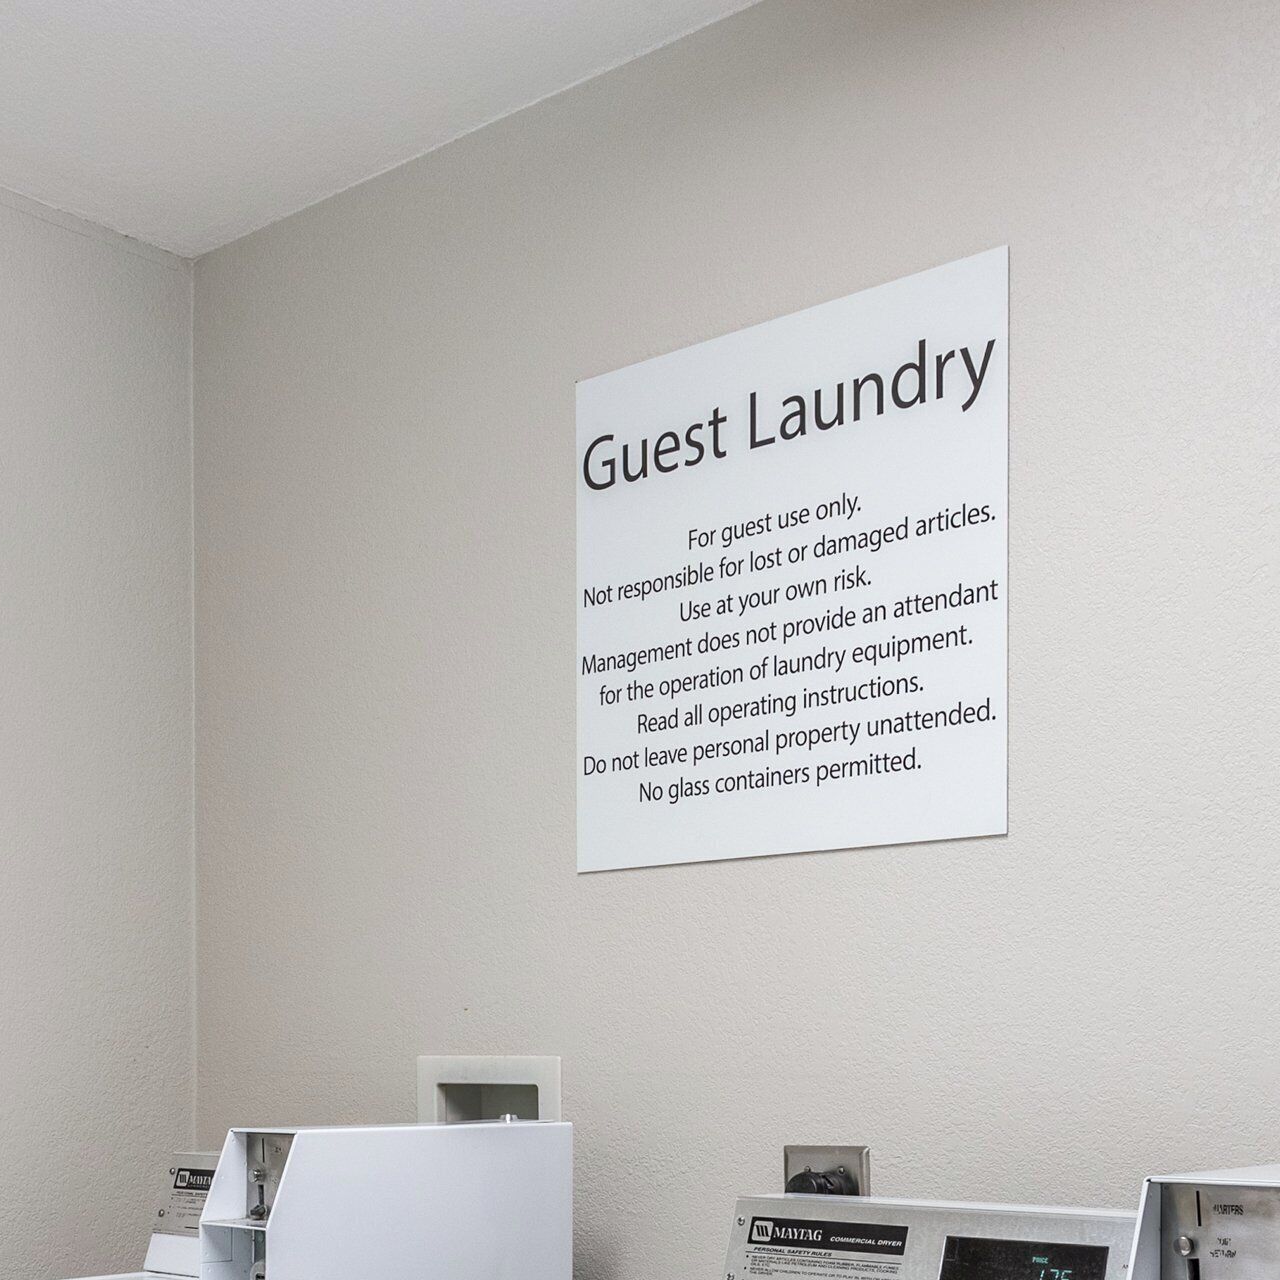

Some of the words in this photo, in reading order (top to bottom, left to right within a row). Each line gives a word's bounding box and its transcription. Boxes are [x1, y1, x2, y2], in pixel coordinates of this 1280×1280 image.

[583, 407, 726, 490] Guest
[749, 338, 996, 450] Laundry
[688, 529, 716, 550] For
[721, 513, 772, 547] guest
[778, 507, 810, 529] use
[816, 492, 861, 520] only.
[583, 585, 613, 608] Not
[618, 562, 714, 600] responsible
[719, 557, 745, 578] for
[750, 548, 783, 573] lost
[788, 544, 808, 564] or
[813, 516, 909, 552] damaged
[915, 503, 996, 537] articles.
[680, 600, 711, 622] Use
[716, 594, 733, 615] at
[739, 587, 780, 617] your
[785, 578, 827, 601] own
[834, 565, 872, 591] risk.
[582, 638, 692, 675] Management
[697, 632, 740, 654] does
[746, 622, 777, 645] not
[783, 606, 856, 644] provide
[862, 603, 887, 624] an
[893, 580, 998, 618] attendant
[600, 684, 622, 706] for
[626, 680, 654, 701] the
[659, 666, 743, 699] operation
[749, 656, 769, 680] of
[773, 647, 846, 677] laundry
[852, 625, 973, 666] equipment.
[637, 708, 679, 734] Read
[684, 703, 703, 727] all
[708, 694, 796, 726] operating
[803, 675, 924, 709] instructions.
[584, 756, 607, 776] Do
[612, 750, 640, 772] not
[644, 747, 688, 767] leave
[693, 729, 769, 766] personal
[776, 721, 860, 755] property
[867, 698, 996, 737] unattended.
[639, 782, 663, 802] No
[668, 777, 710, 804] glass
[715, 767, 810, 793] containers
[816, 747, 921, 787] permitted.
[189, 1175, 211, 1185] MAYTA
[773, 1227, 822, 1241] MAYTAG
[830, 1236, 876, 1245] COMMERCIAL
